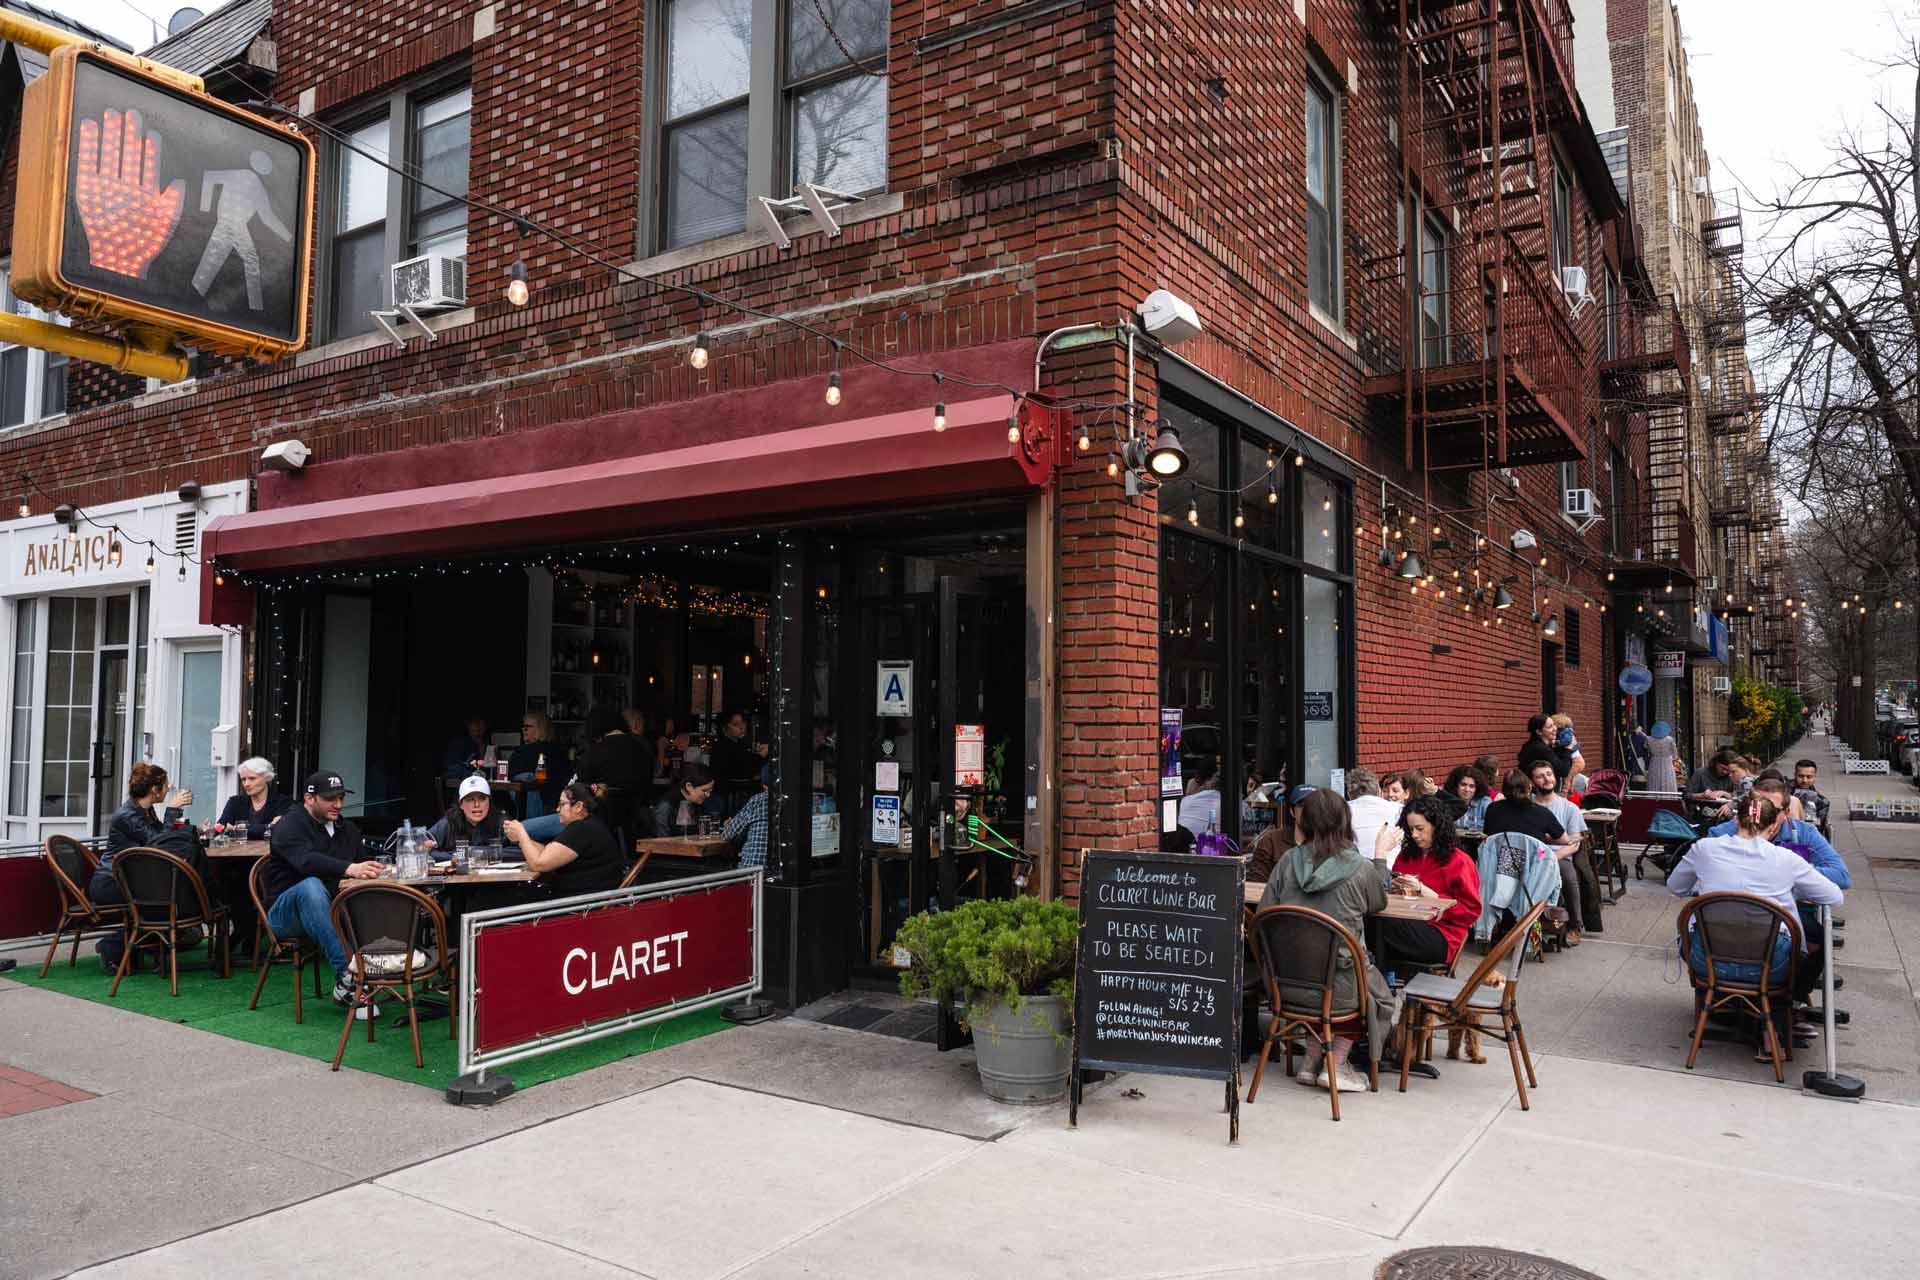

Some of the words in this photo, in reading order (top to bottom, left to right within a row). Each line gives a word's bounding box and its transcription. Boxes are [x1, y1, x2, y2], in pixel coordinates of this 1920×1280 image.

[1657, 653, 1678, 661] FOR
[884, 673, 904, 702] A
[1116, 866, 1180, 885] Welcome
[1184, 872, 1196, 886] to
[1108, 921, 1158, 940] PLEASE
[1165, 924, 1202, 944] WAIT
[562, 931, 689, 996] CLARET
[1093, 941, 1111, 956] TO
[1120, 943, 1137, 958] BE
[1145, 944, 1214, 968] SEATED!
[1100, 974, 1135, 991] HAPPY
[1138, 978, 1168, 992] HOUR
[1171, 983, 1192, 997] M/F
[1195, 986, 1215, 1002] 4-6
[1169, 998, 1188, 1011] S/S
